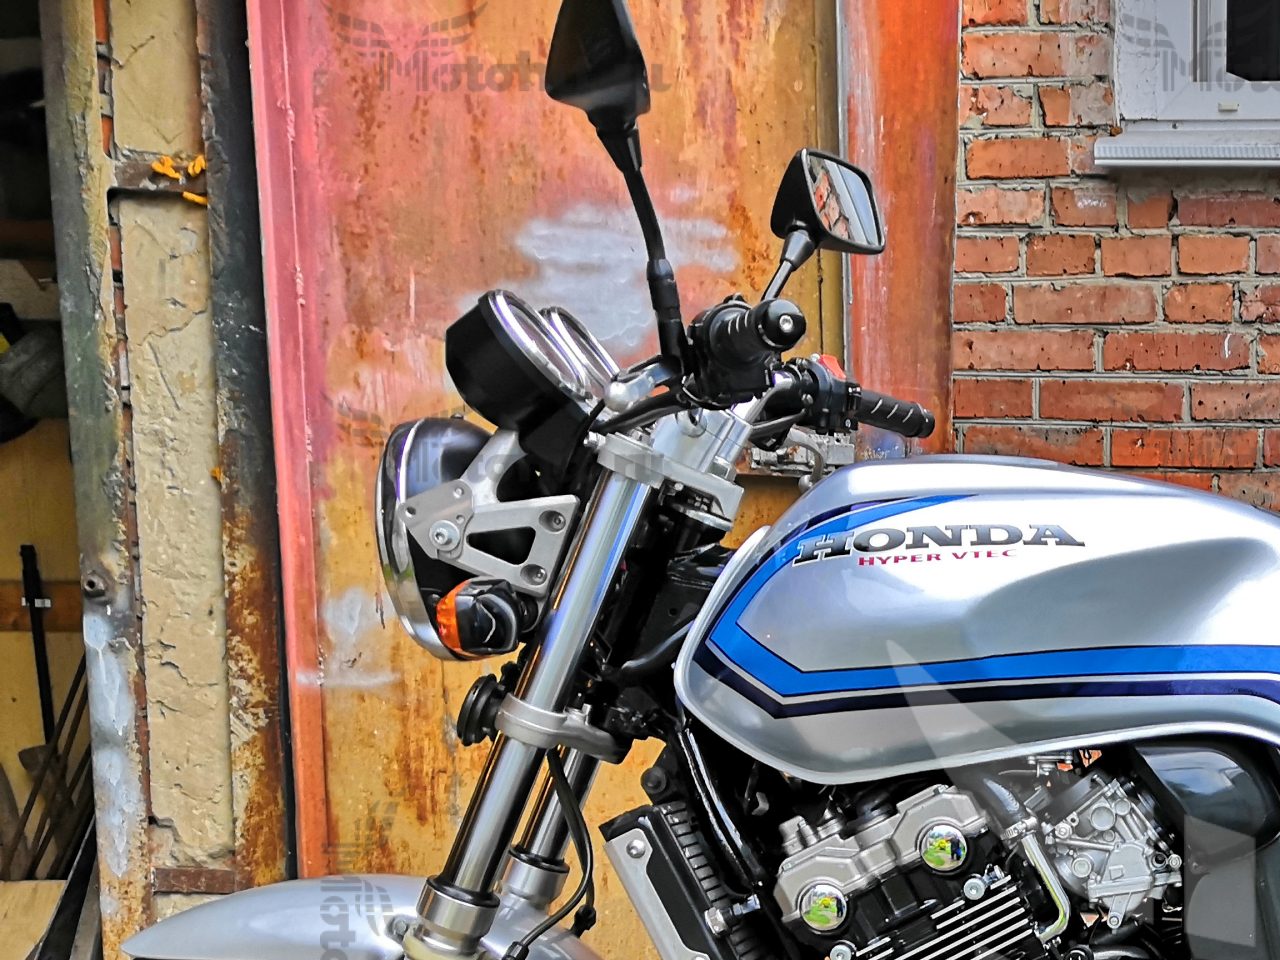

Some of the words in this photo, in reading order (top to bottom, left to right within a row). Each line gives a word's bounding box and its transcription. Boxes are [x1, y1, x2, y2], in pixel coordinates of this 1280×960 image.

[792, 524, 1085, 567] HONDA
[858, 551, 942, 567] HYPER
[952, 548, 1018, 560] VTEC
